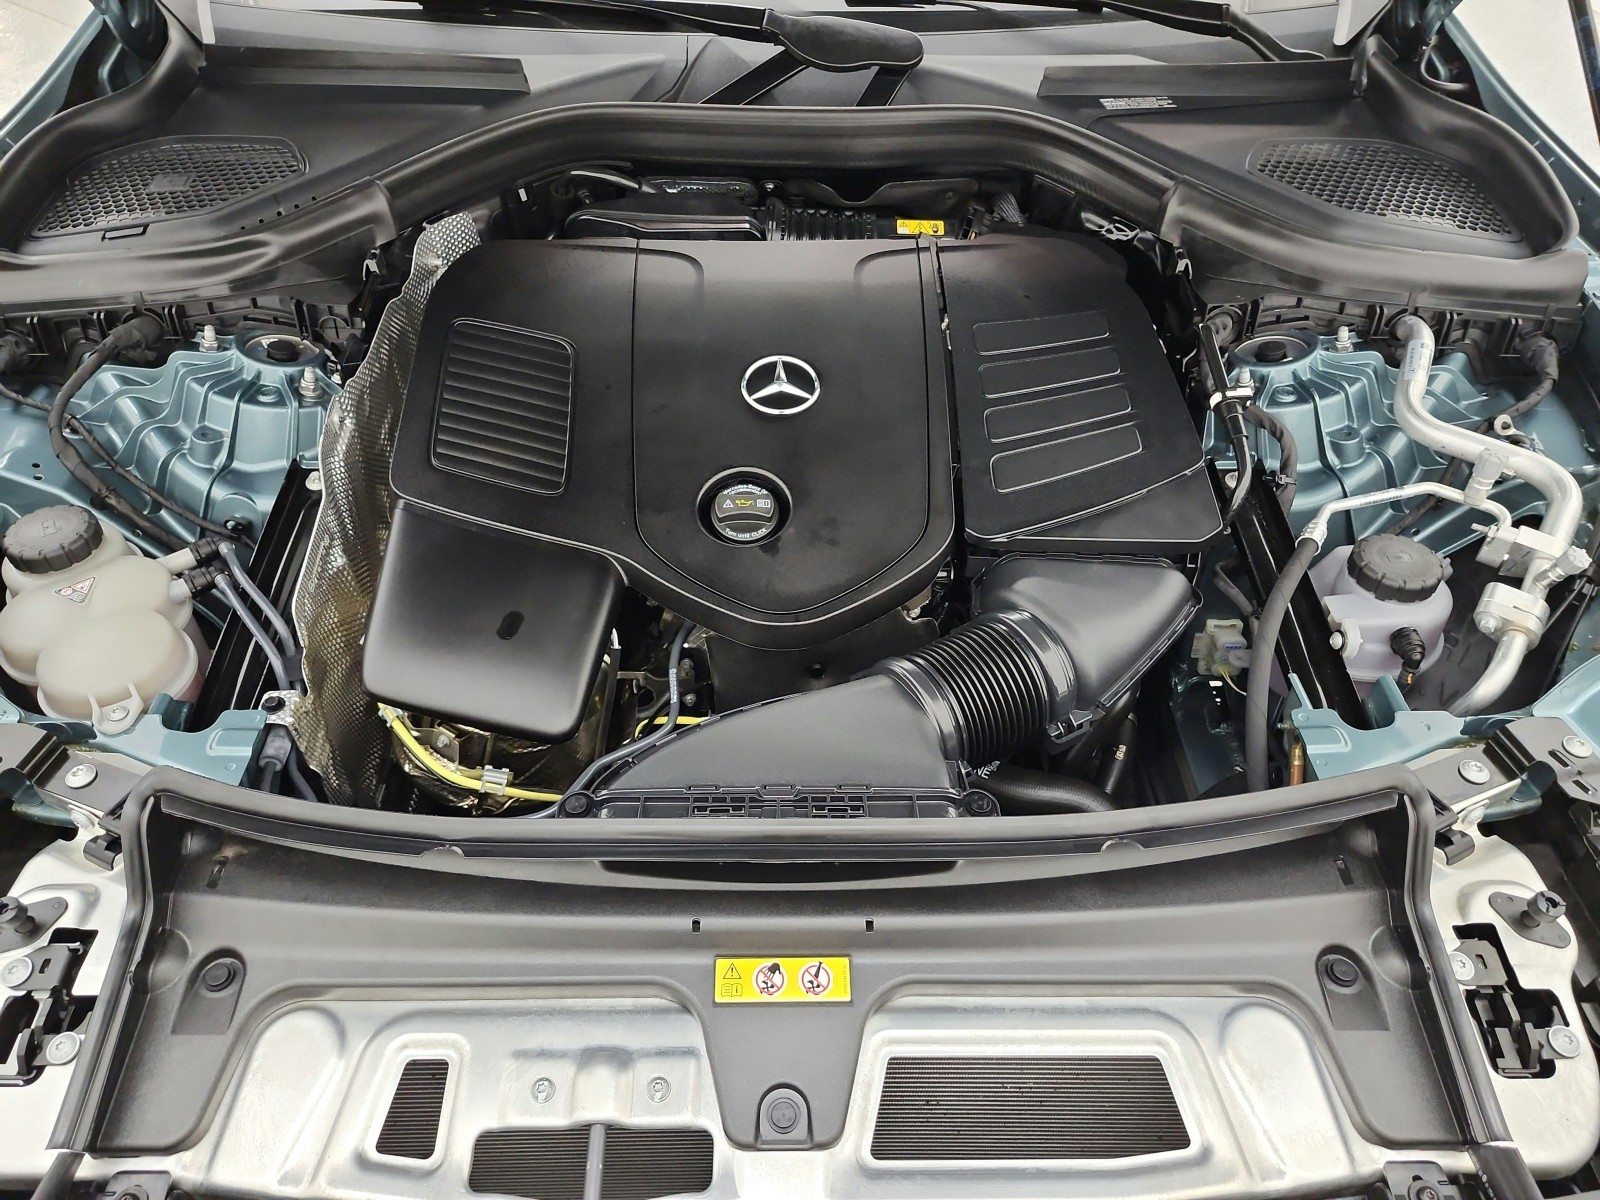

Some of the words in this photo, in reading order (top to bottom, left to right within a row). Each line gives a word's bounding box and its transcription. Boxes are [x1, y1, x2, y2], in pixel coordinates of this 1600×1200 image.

[722, 484, 761, 494] Mercedes-Benz
[725, 527, 737, 536] Turn
[751, 527, 767, 537] CLICK
